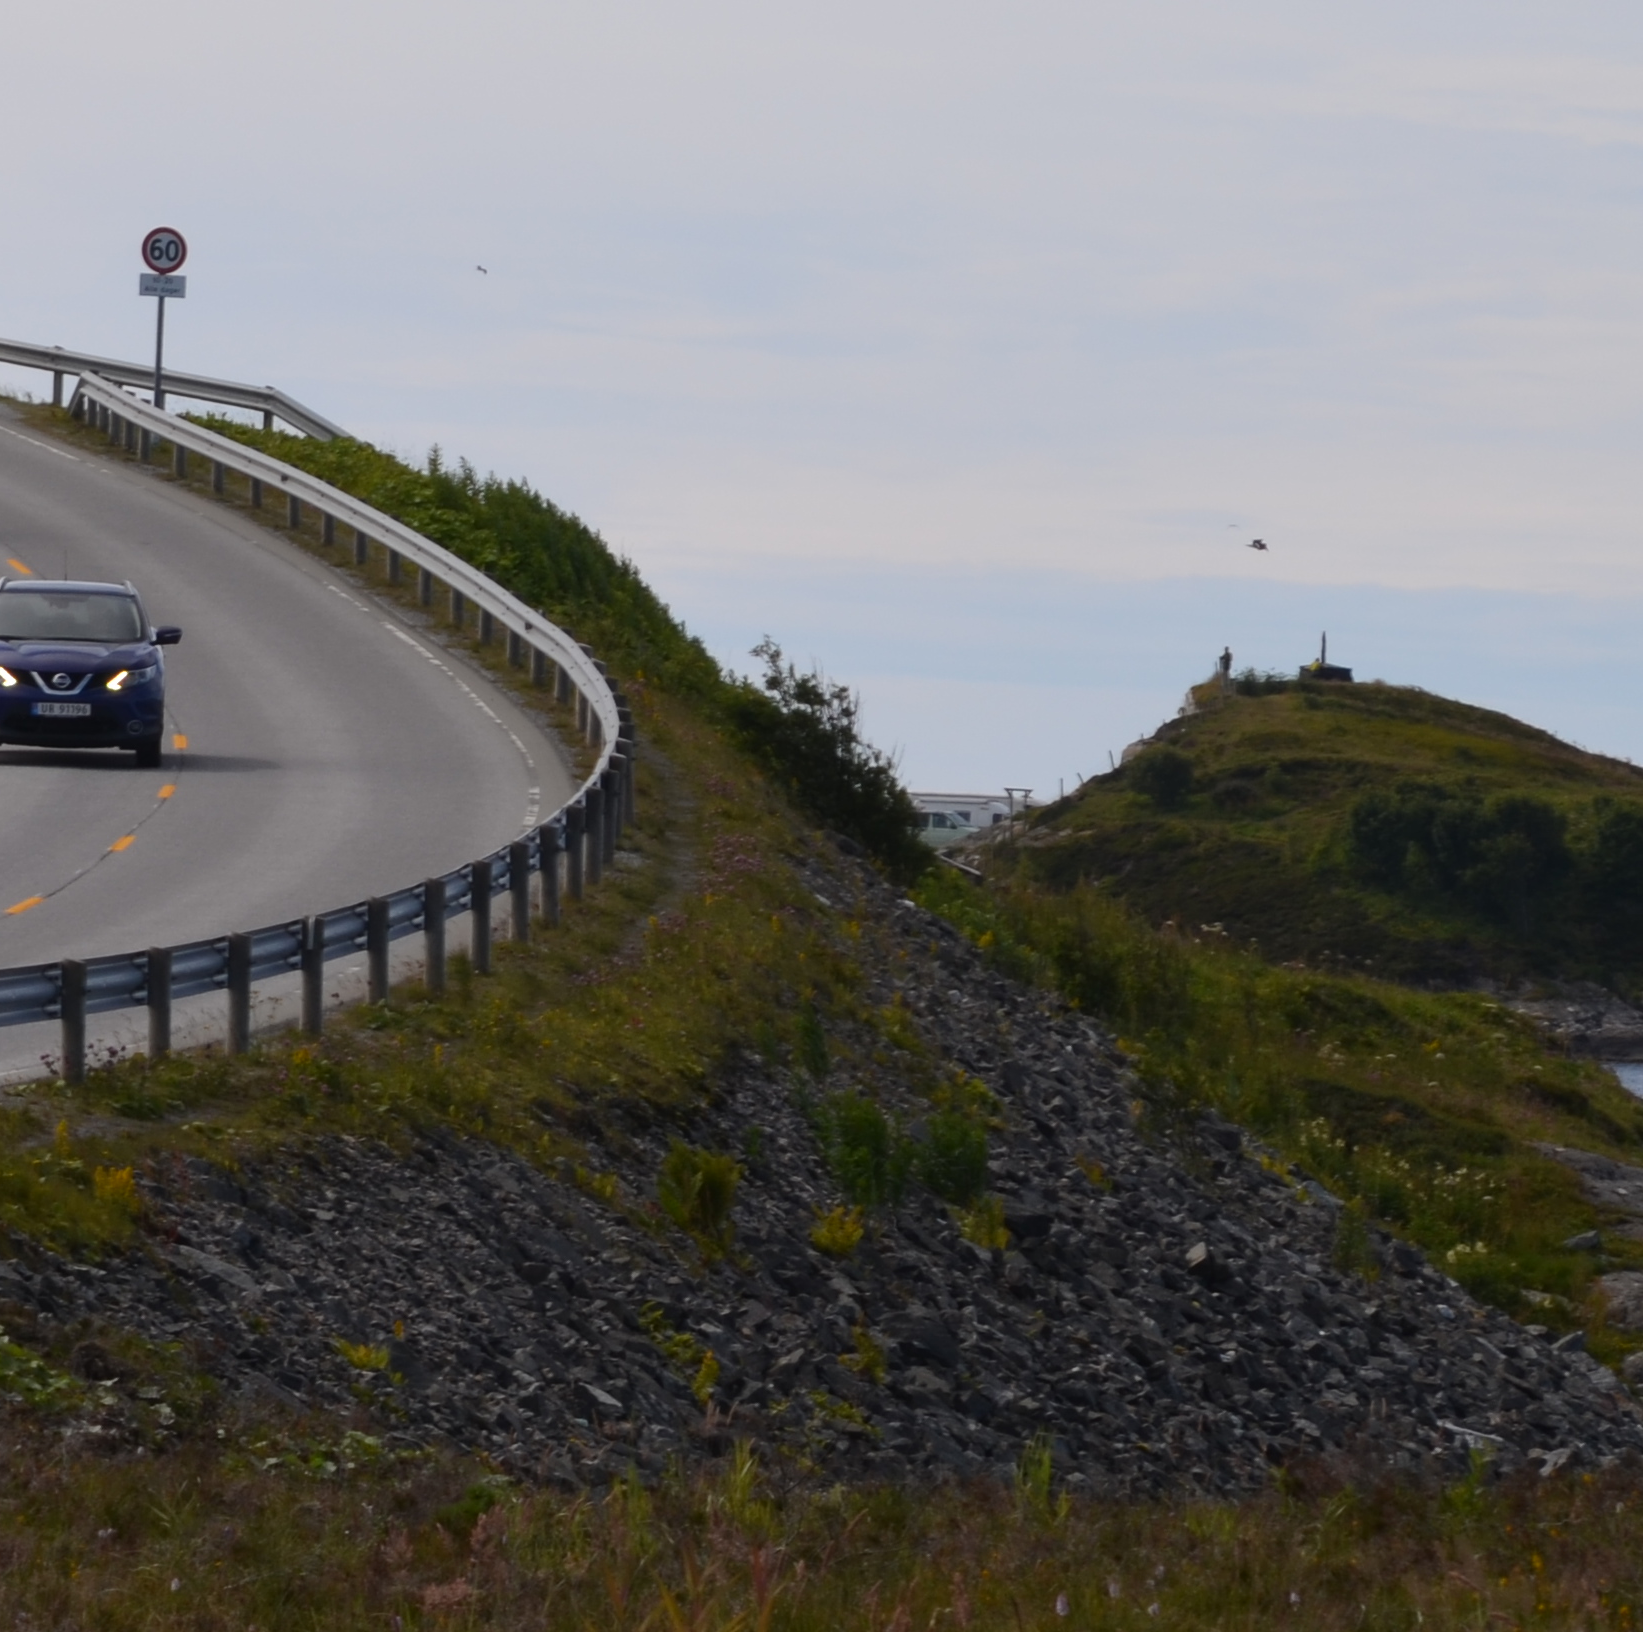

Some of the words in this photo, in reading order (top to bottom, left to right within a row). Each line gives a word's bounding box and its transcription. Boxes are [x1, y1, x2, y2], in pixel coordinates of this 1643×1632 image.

[149, 238, 180, 262] 60
[41, 704, 55, 714] UR
[59, 704, 88, 715] 91196
